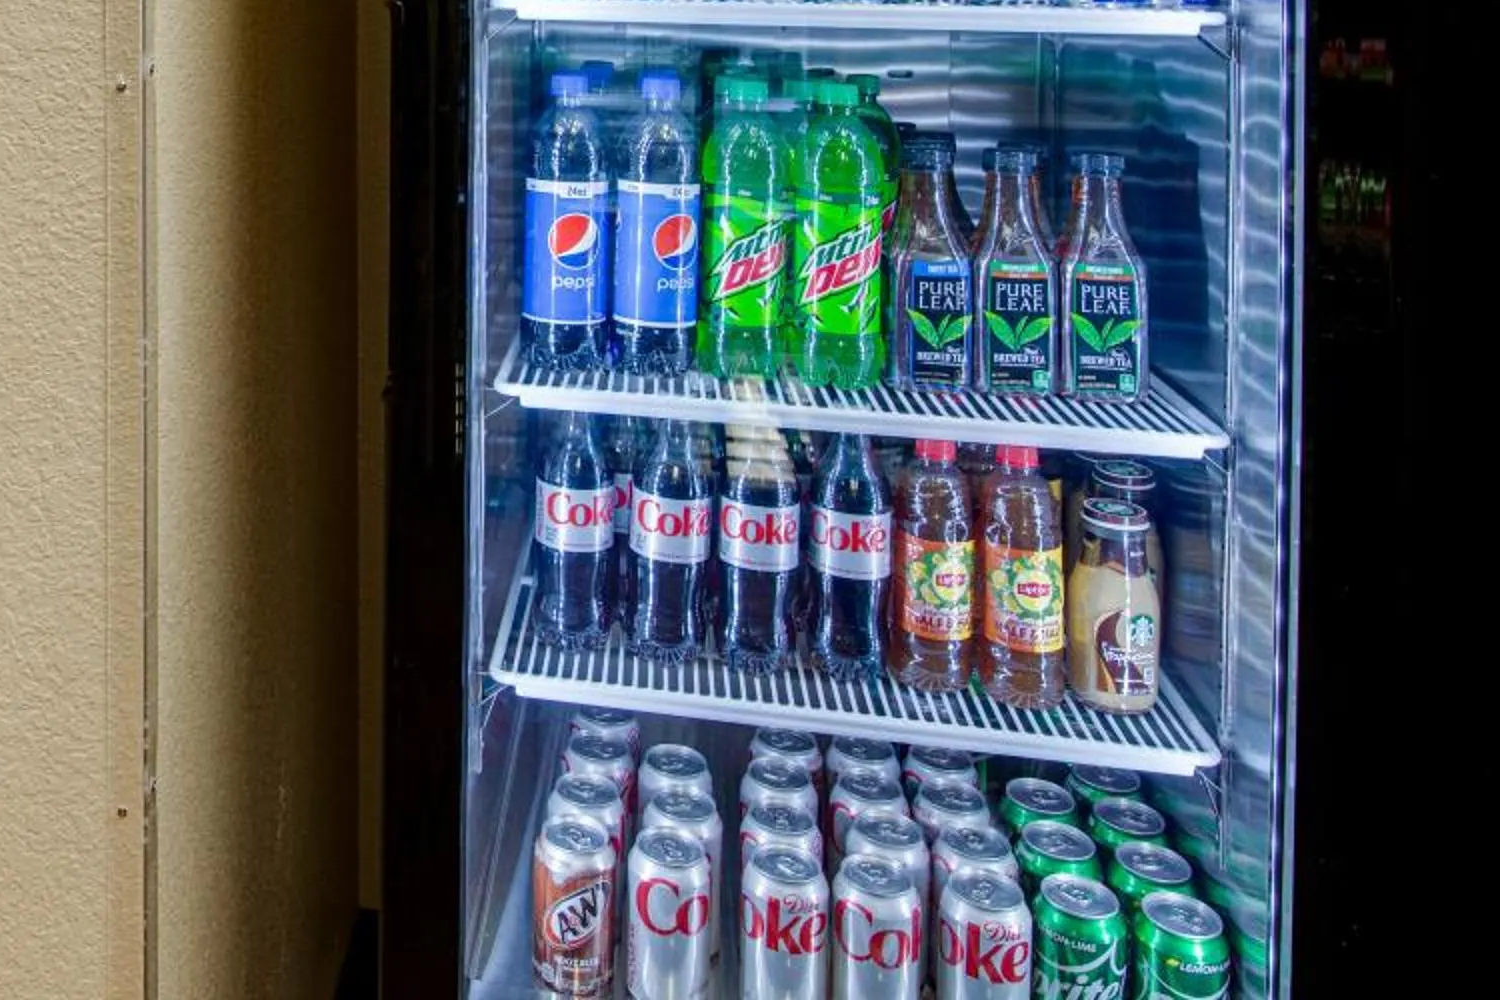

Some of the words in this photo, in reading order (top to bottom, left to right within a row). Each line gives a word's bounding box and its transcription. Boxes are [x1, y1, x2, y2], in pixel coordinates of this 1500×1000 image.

[919, 281, 965, 296] PURE
[995, 281, 1044, 298] PURE
[1081, 283, 1130, 301] PURE
[919, 296, 966, 311] LEAF
[995, 297, 1045, 312] LEAF
[1081, 299, 1131, 315] LEAF
[720, 503, 797, 546] Coke
[810, 509, 887, 553] Coke
[556, 886, 598, 945] A&W
[939, 918, 1030, 985] oke
